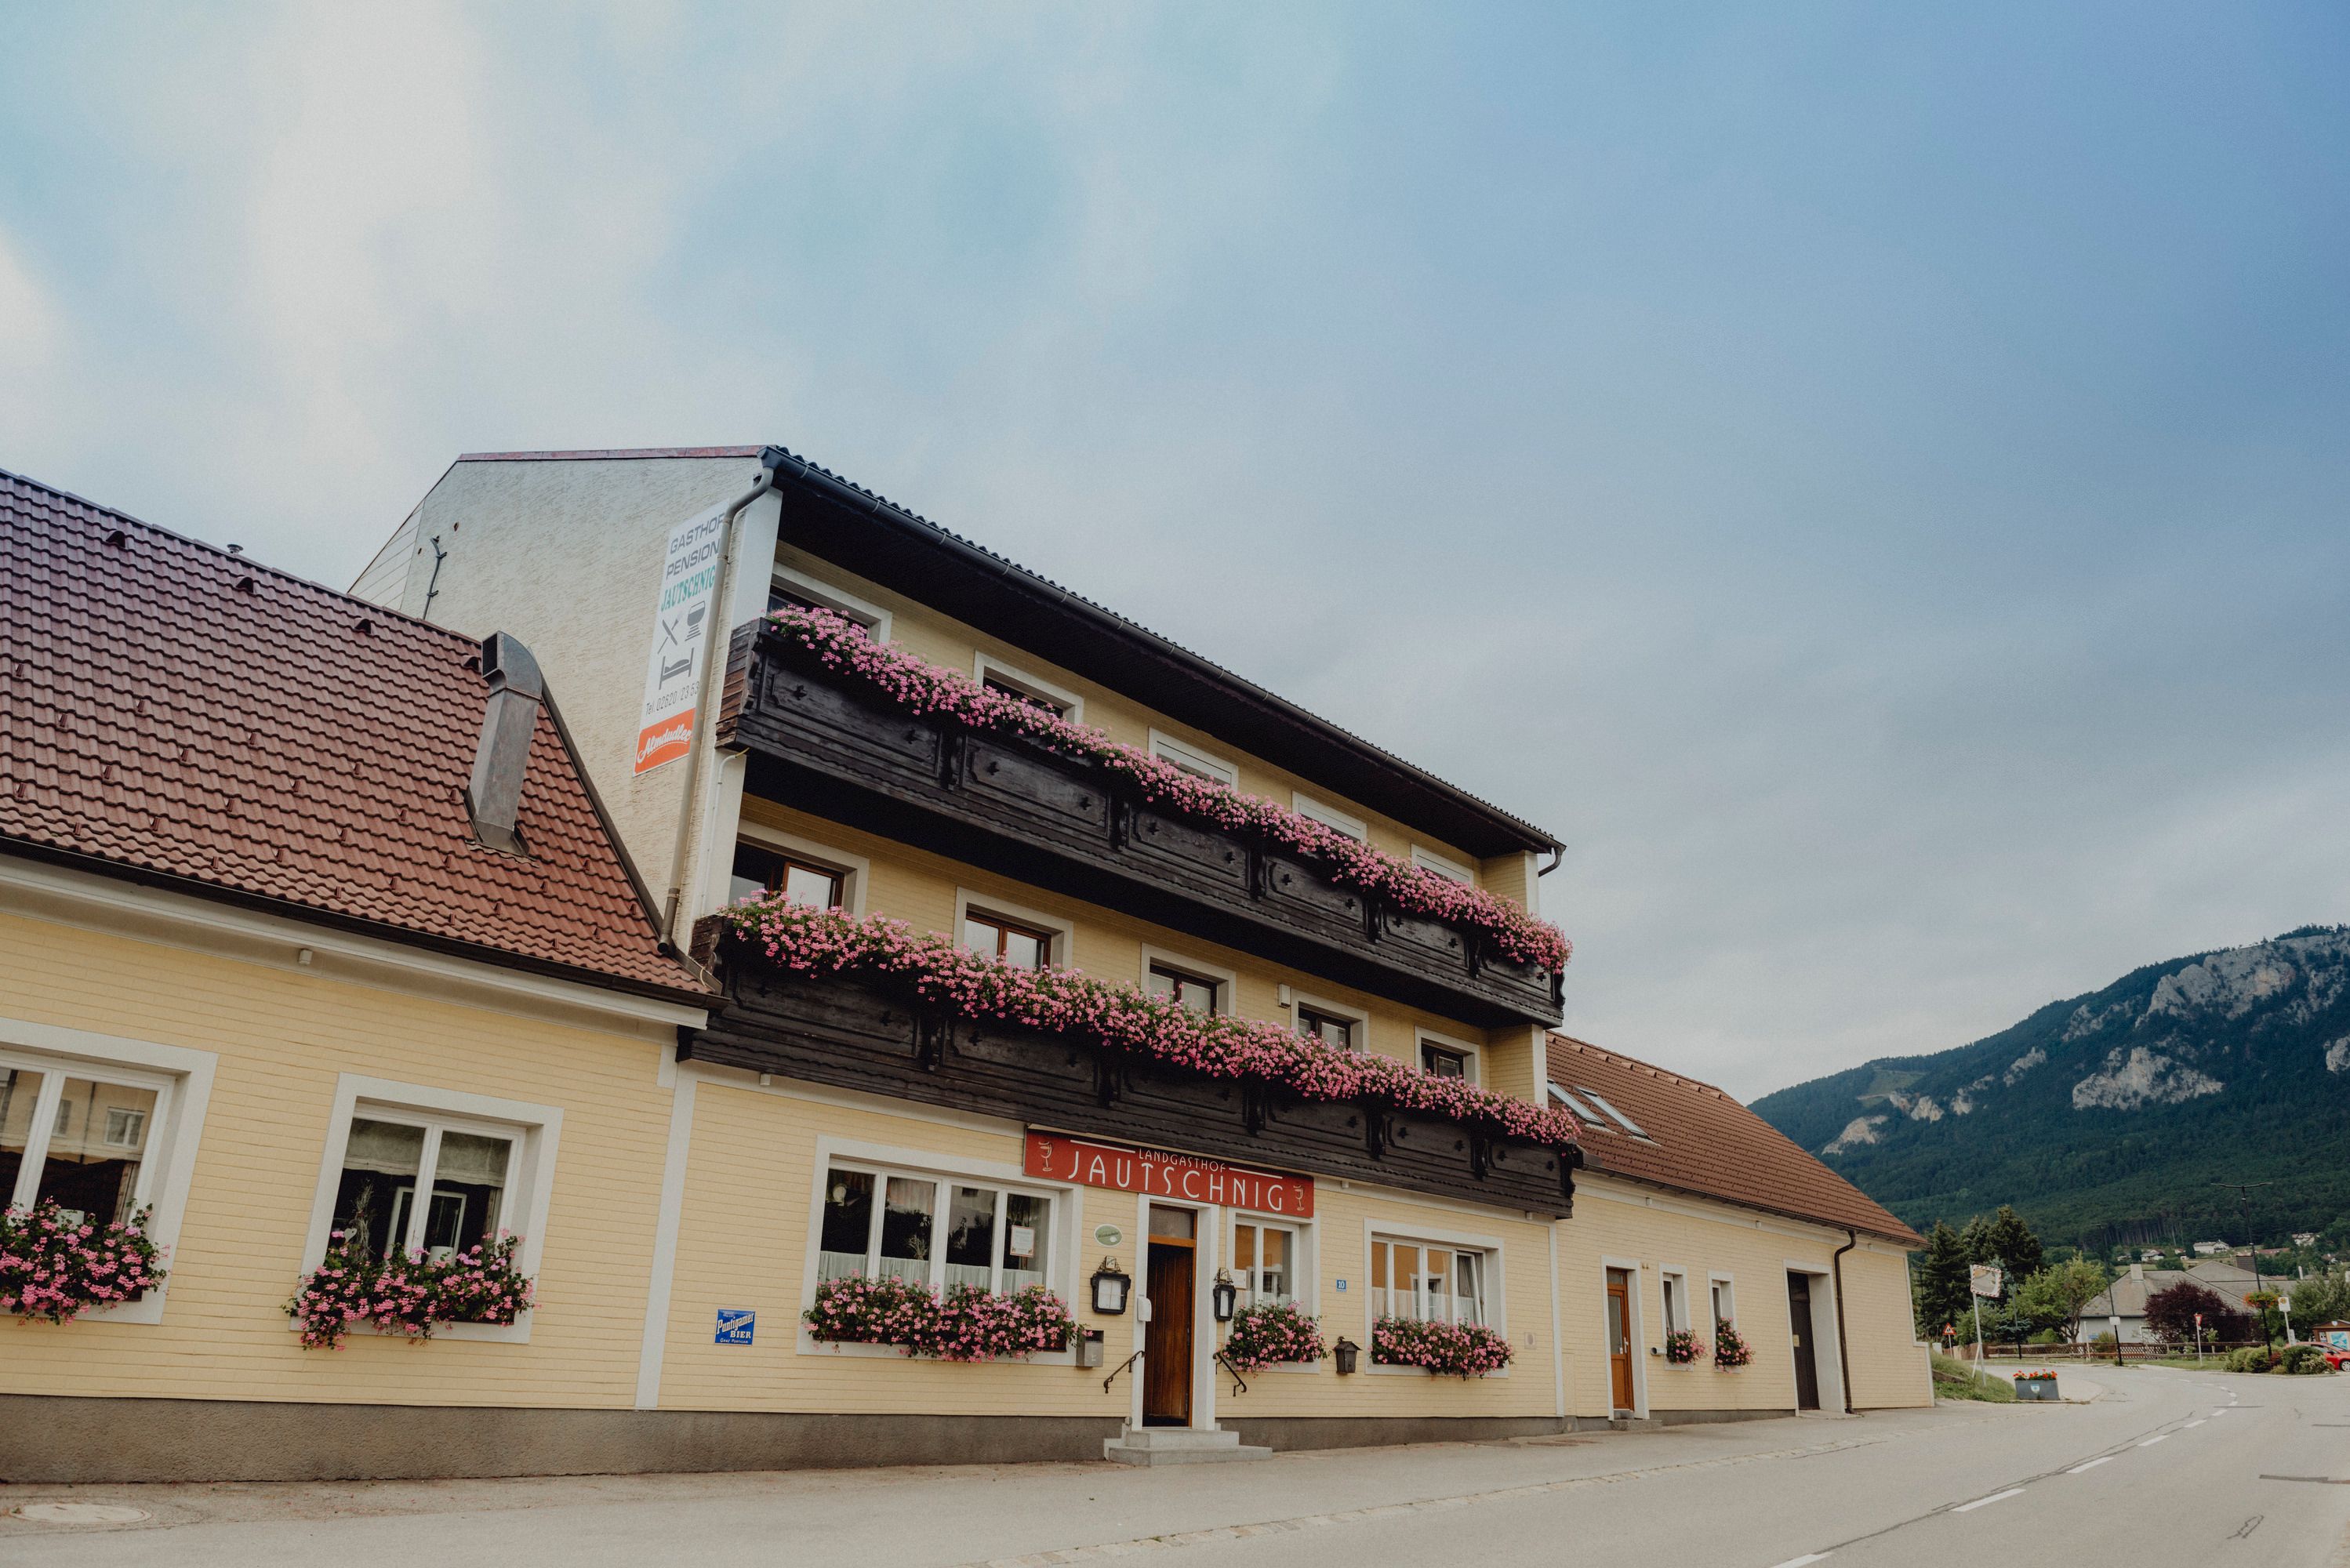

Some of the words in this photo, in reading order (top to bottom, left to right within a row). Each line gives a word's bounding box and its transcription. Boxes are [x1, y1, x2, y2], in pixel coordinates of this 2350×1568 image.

[670, 513, 725, 554] GASTHOF
[666, 538, 721, 579] PENSION
[661, 565, 716, 612] JAUTSCHNIG
[637, 723, 692, 764] Almdudler
[1139, 1148, 1226, 1173] LANDGASTHOF
[1068, 1151, 1284, 1212] JAUTSCHNIG
[1338, 1280, 1345, 1289] 10
[716, 1312, 754, 1335] Puntigamer
[730, 1330, 751, 1339] BIER
